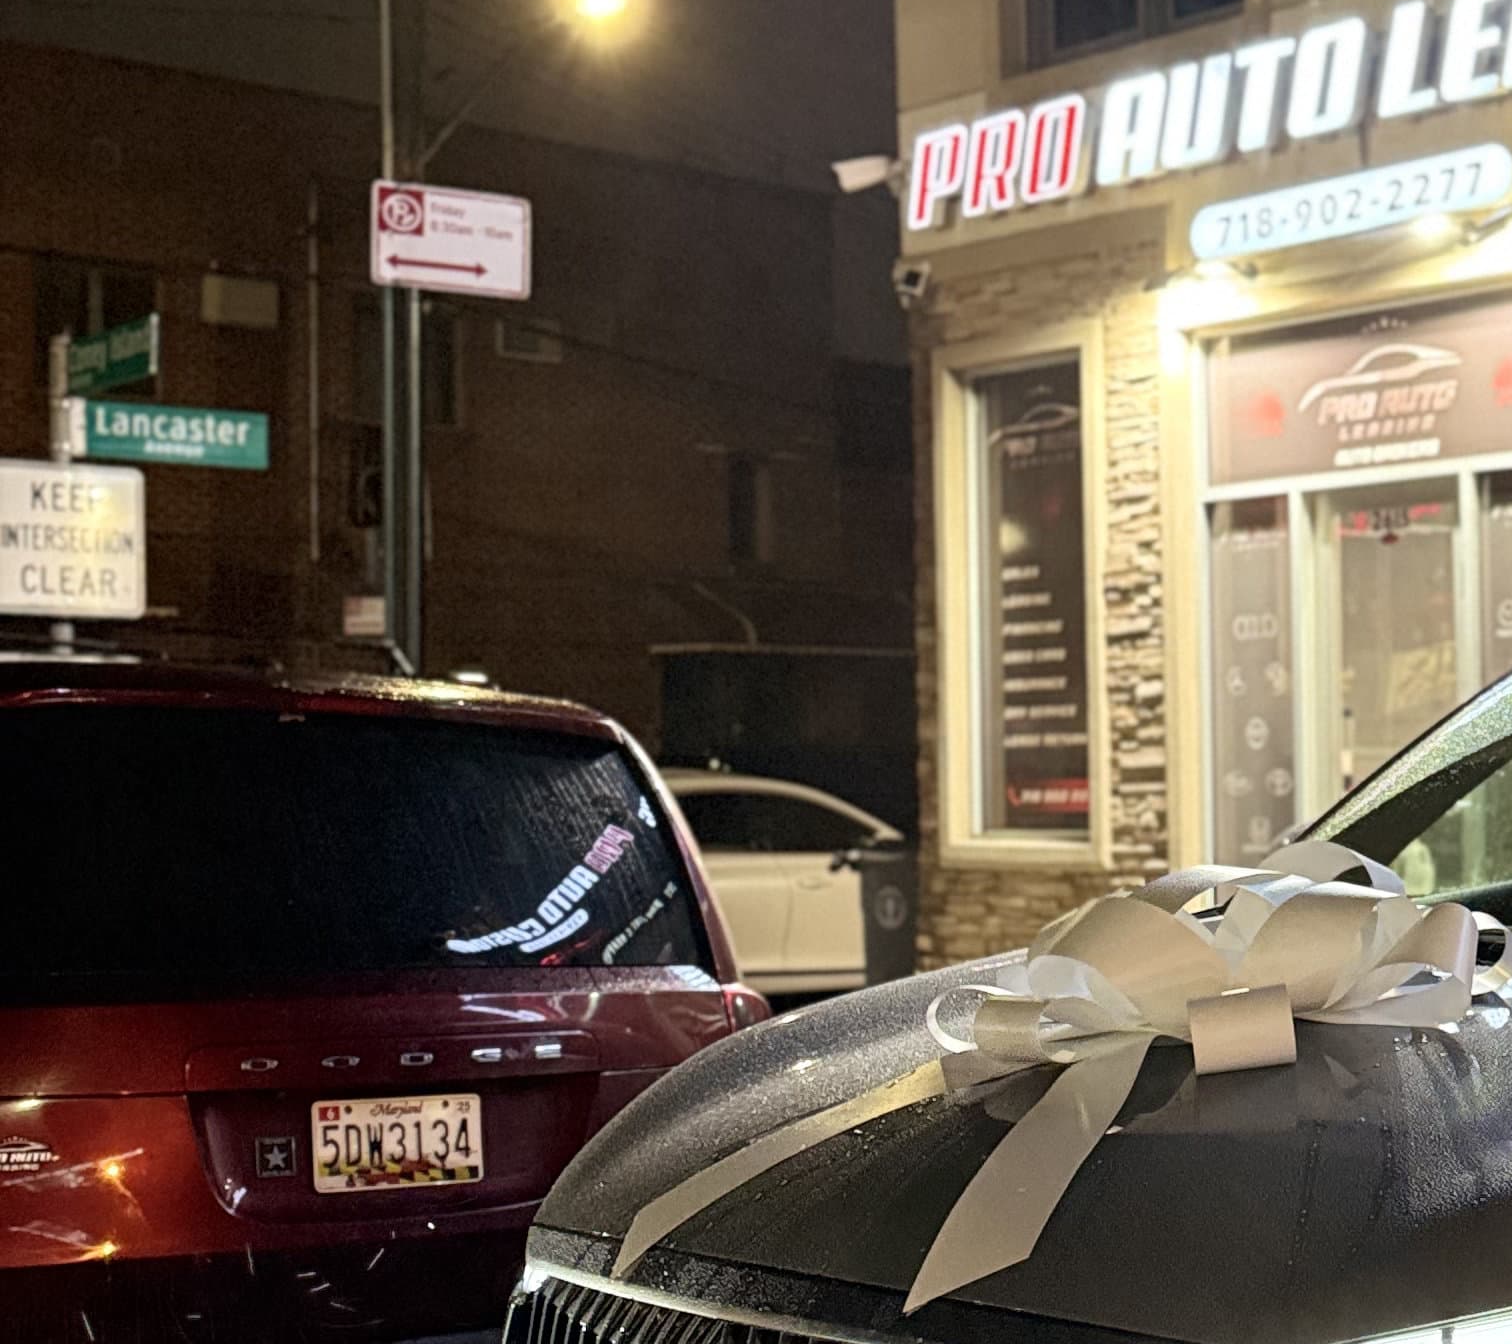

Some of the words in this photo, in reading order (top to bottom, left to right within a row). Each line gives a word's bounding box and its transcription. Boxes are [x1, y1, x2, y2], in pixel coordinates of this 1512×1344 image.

[906, 93, 1086, 232] PRO
[1094, 16, 1372, 186] AUTO
[1215, 161, 1484, 248] 718-902-2277
[95, 406, 251, 446] Lancaster
[1316, 390, 1379, 426] PRO
[1378, 379, 1459, 418] AUTO
[20, 563, 118, 599] CLEAR
[369, 1101, 425, 1117] Maryland
[319, 1117, 474, 1171] 5DW3134
